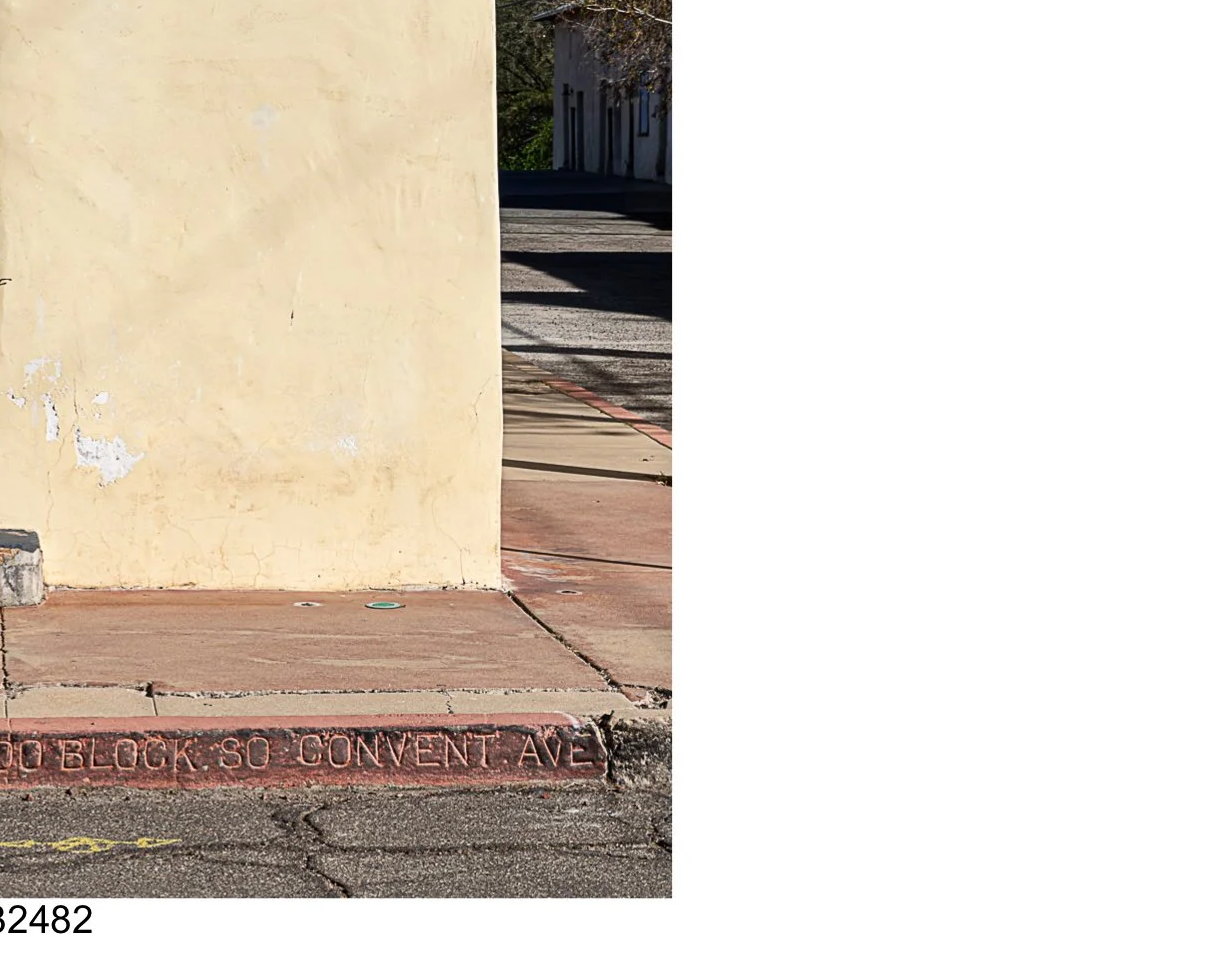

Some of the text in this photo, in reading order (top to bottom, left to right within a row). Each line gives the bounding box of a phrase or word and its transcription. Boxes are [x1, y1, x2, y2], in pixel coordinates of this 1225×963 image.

[61, 736, 197, 773] BLOCK
[220, 737, 271, 769] SO
[298, 733, 497, 769] CONVENT
[518, 732, 595, 767] AVE
